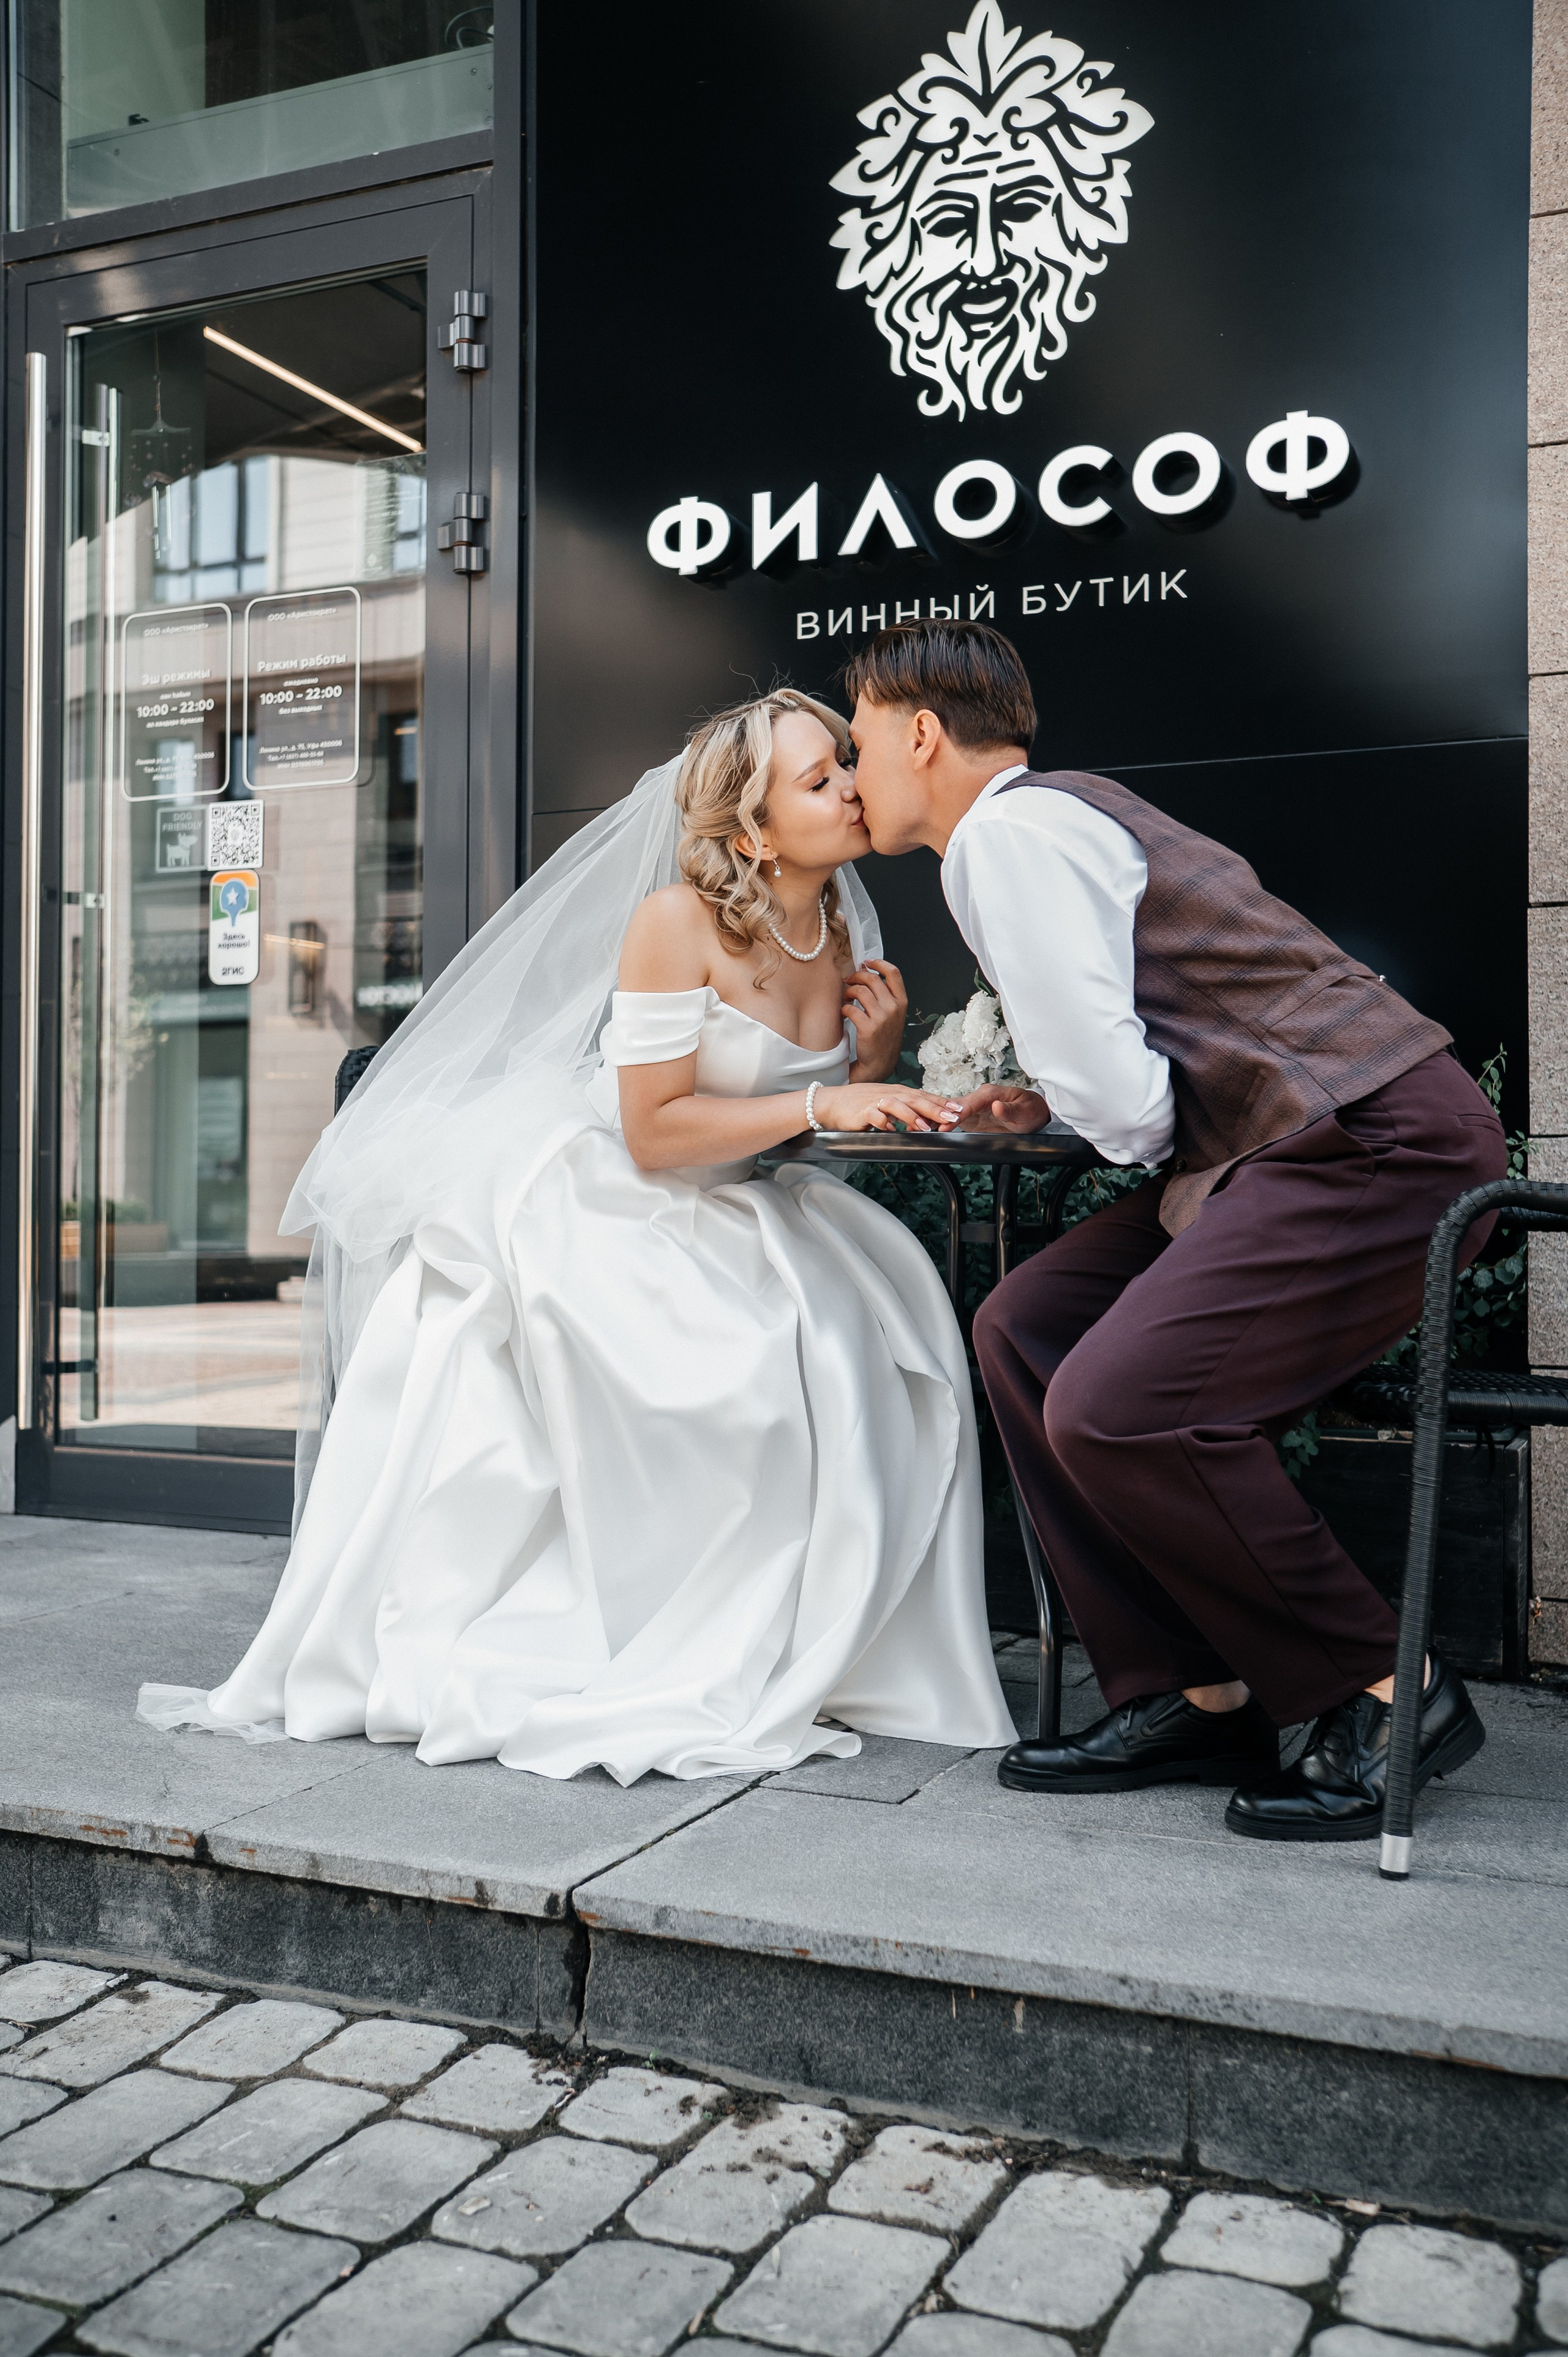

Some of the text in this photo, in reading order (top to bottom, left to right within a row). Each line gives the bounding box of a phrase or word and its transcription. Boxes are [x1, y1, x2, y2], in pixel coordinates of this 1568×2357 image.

[647, 410, 1350, 575] ФИЛОСОФ
[797, 569, 1188, 639] ВИННЫЙ БУТИК
[257, 654, 347, 673] Режим работы
[161, 669, 211, 685] режимы
[260, 690, 294, 705] 10:00
[305, 685, 342, 700] 22:00
[137, 703, 169, 718] 10:00
[179, 698, 214, 714] 22:00
[173, 812, 193, 822] DOG
[162, 821, 203, 832] FRIENDLY
[218, 940, 251, 949] хорошо!
[222, 967, 245, 976] 2ГИС
